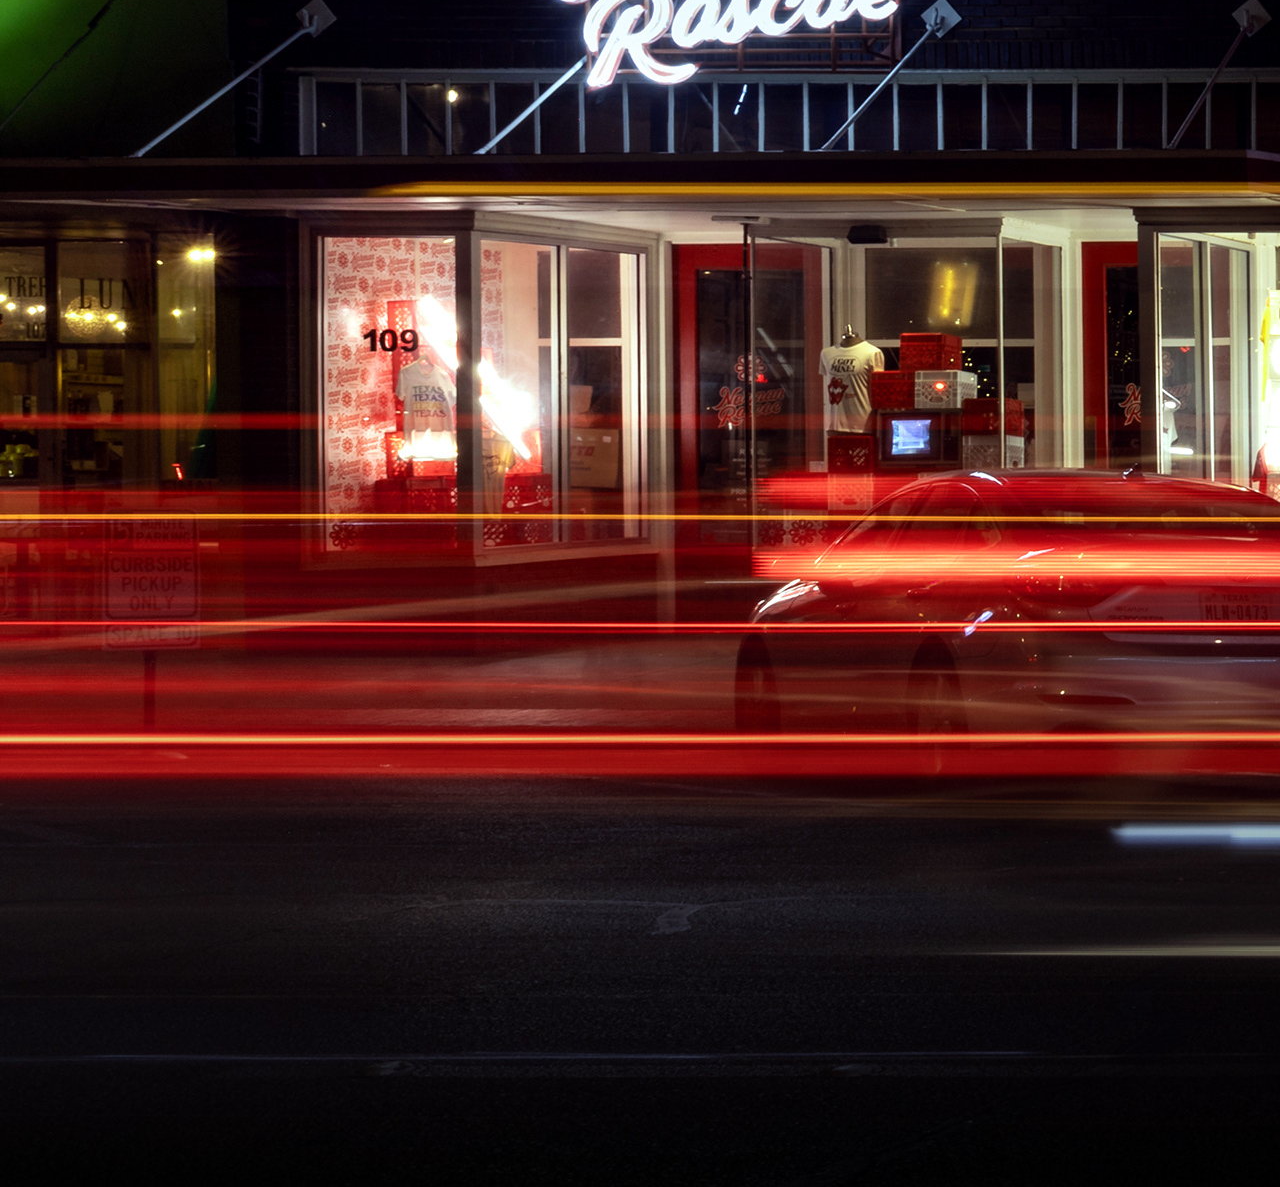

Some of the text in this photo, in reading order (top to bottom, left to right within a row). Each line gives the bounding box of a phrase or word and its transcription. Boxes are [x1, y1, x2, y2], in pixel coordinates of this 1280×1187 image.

[363, 329, 419, 352] 109
[412, 385, 445, 394] TEXAS
[412, 393, 446, 402] TEXAS
[712, 386, 785, 410] Noman
[413, 409, 447, 418] TEXAS
[717, 401, 782, 429] Rocoe
[136, 531, 191, 544] PARKING
[110, 557, 193, 573] CURBSIDE
[121, 576, 182, 592] PICKUP
[129, 595, 175, 611] ONLY
[1222, 594, 1250, 602] TEXAS
[111, 626, 168, 642] SPACE
